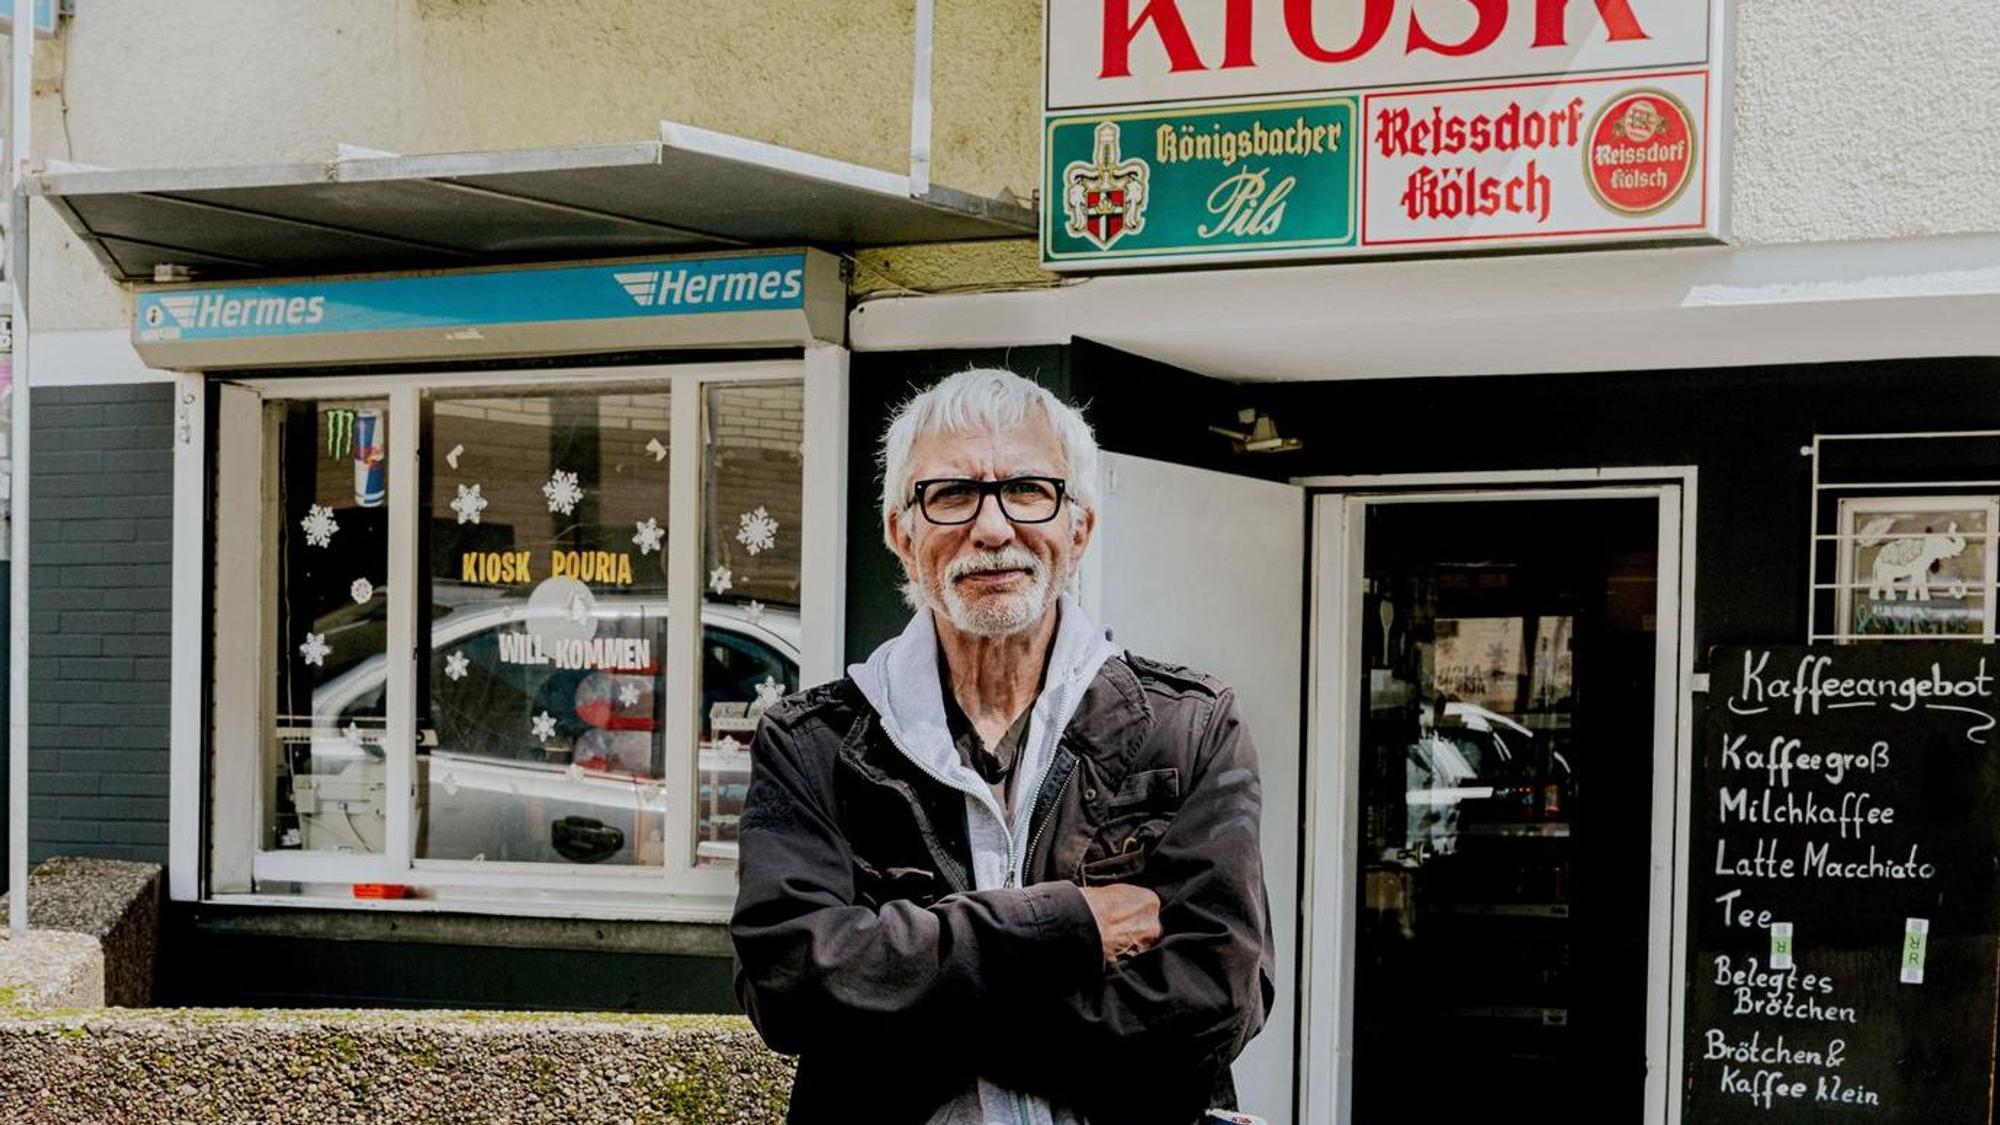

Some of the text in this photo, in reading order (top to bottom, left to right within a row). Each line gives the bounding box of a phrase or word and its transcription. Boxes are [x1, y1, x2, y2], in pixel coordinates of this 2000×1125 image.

[1156, 116, 1342, 167] Königsbacher
[1374, 96, 1584, 158] Reissdorf
[1594, 139, 1685, 166] Reissdorf
[1400, 158, 1551, 223] Kölsch
[1611, 166, 1668, 190] Kölsch
[1197, 164, 1296, 239] Pils
[658, 269, 802, 305] Hermes
[198, 295, 325, 327] Hermes
[462, 550, 633, 584] KIOSK POURIA
[498, 632, 650, 670] WILL KOMMEN
[1738, 650, 1994, 715] Kaffeeangebot
[1719, 787, 1895, 839] Milchkaffee
[1715, 838, 1936, 878] Latte Macchiato
[1715, 888, 1772, 928] Tee
[1714, 955, 1833, 997] Belegtes
[1732, 987, 1857, 1023] Brötchen
[1720, 1065, 1879, 1109] Kaffee klein
